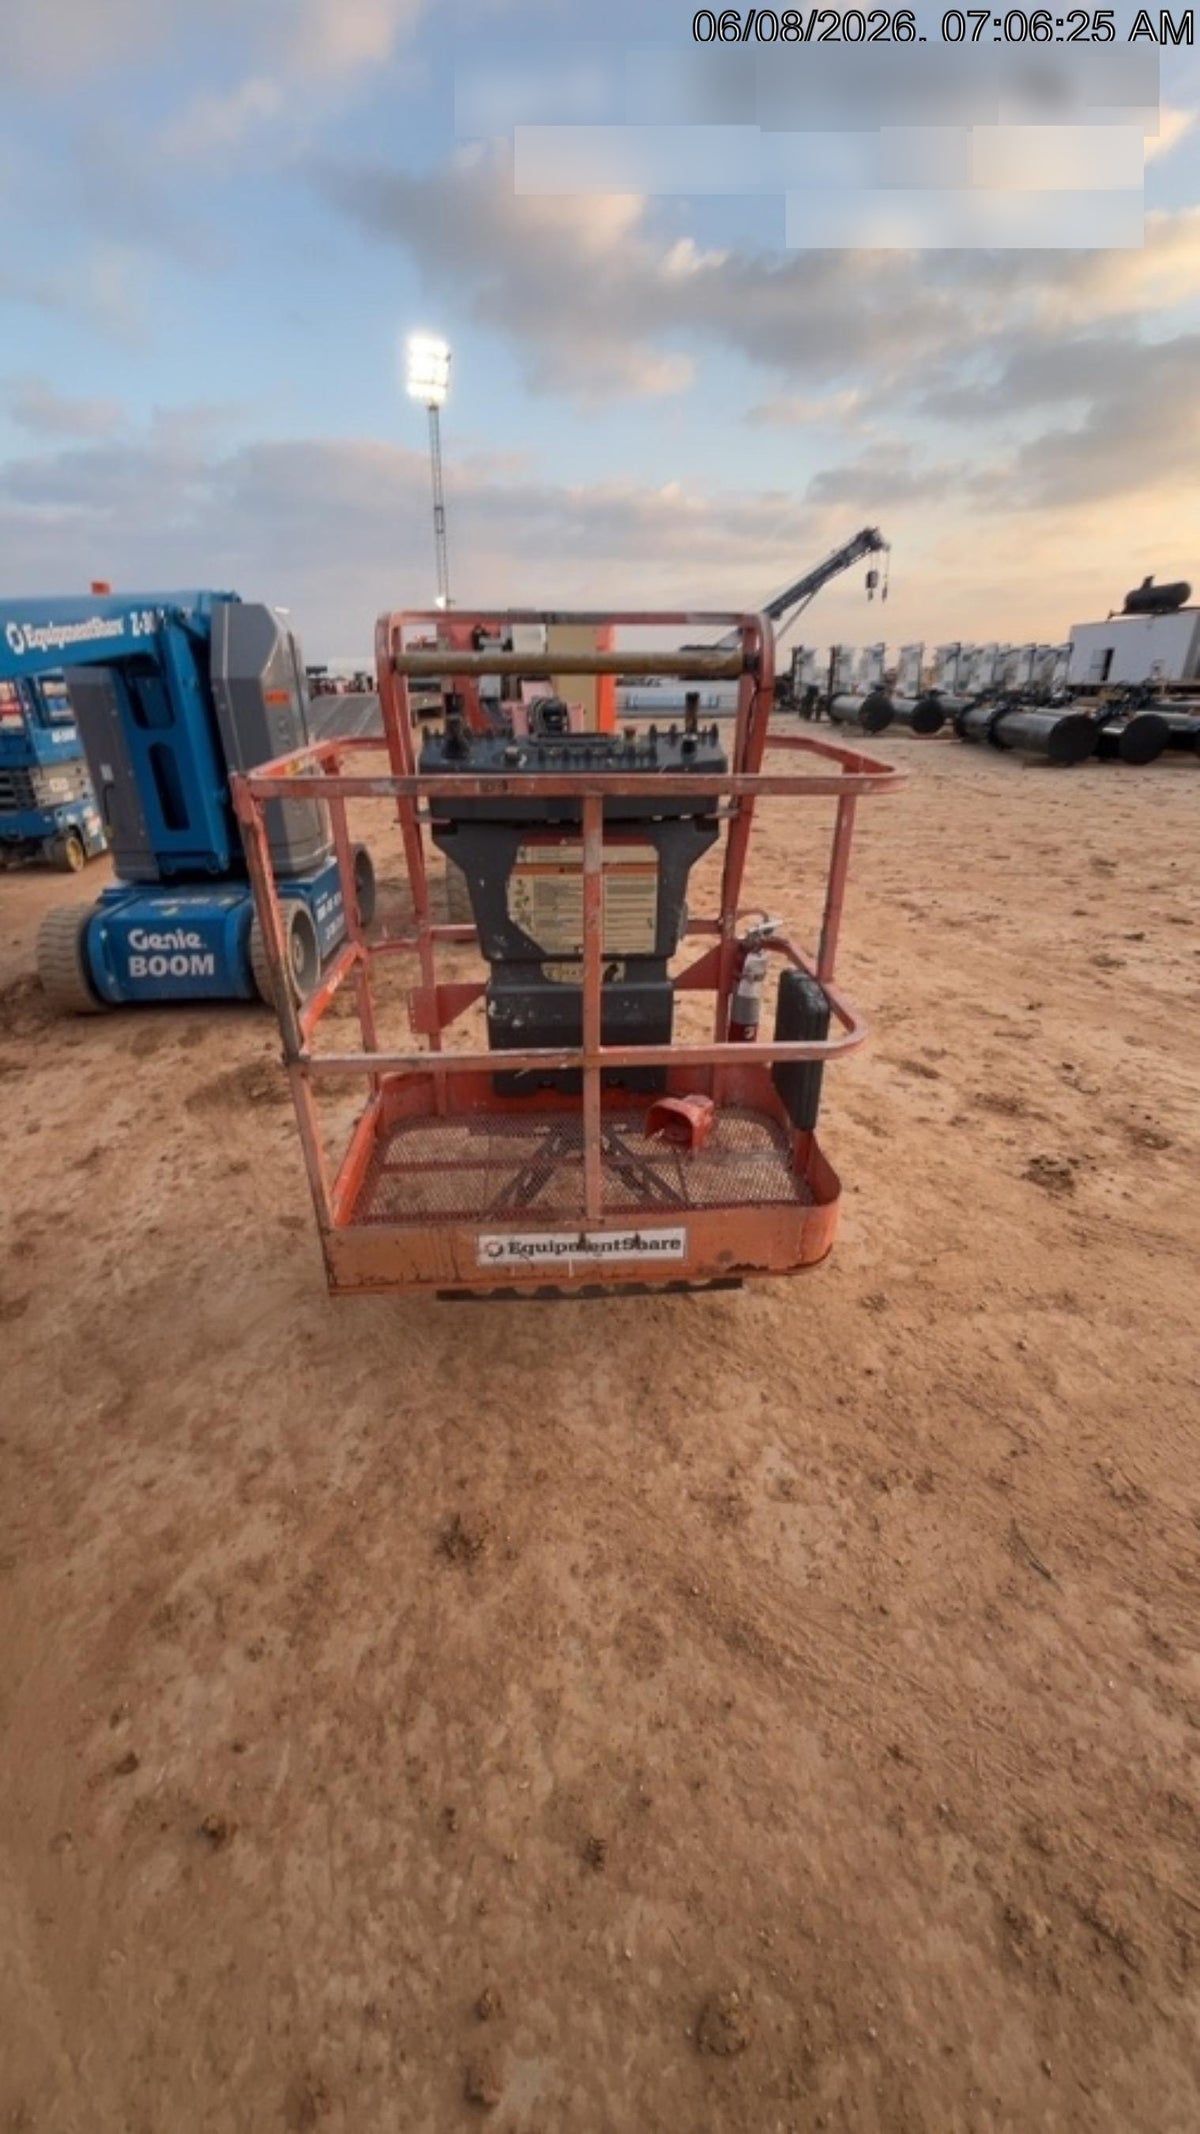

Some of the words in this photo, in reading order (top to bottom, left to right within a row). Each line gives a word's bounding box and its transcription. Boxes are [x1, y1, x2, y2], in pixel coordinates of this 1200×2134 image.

[128, 927, 202, 950] Genie
[128, 953, 214, 977] BOOM
[507, 1237, 681, 1256] EquipmentShare
